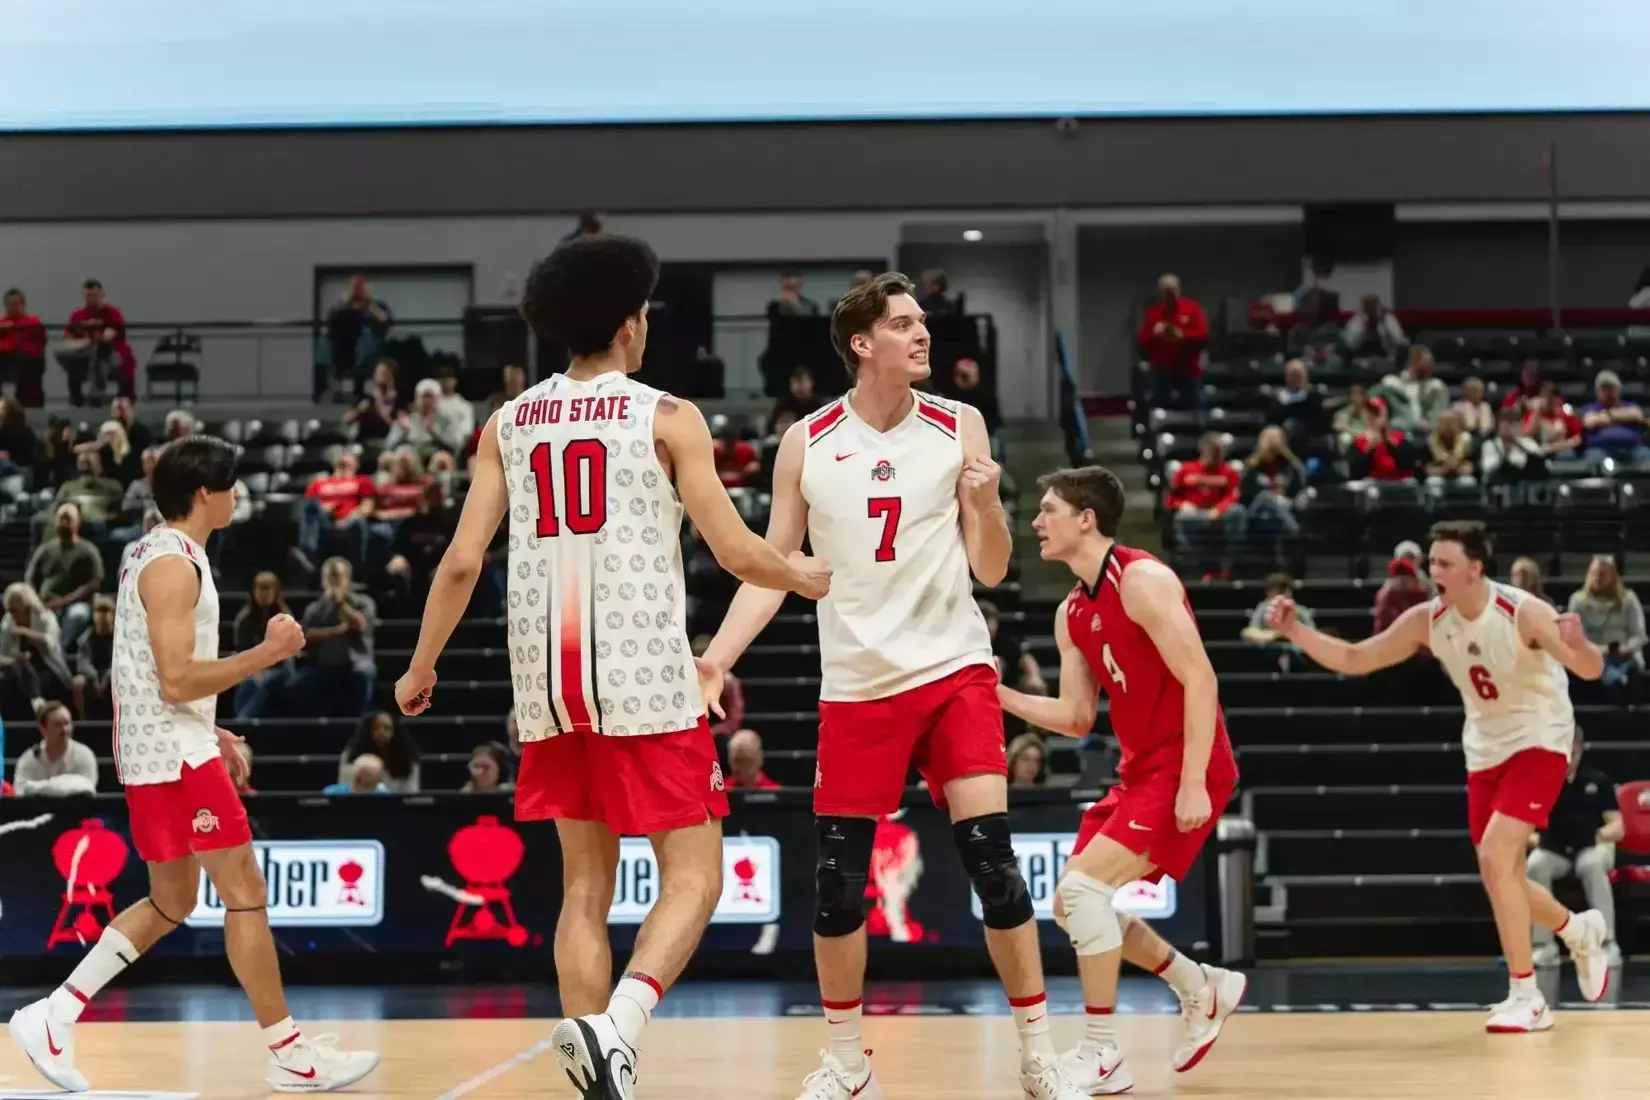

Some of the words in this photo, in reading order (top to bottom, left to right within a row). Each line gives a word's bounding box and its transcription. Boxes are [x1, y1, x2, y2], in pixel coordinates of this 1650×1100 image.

[515, 399, 563, 427] OHIO
[569, 395, 631, 422] STATE
[530, 438, 608, 538] 10
[867, 496, 902, 562] 7
[1101, 642, 1128, 694] 4
[1468, 664, 1500, 701] 6
